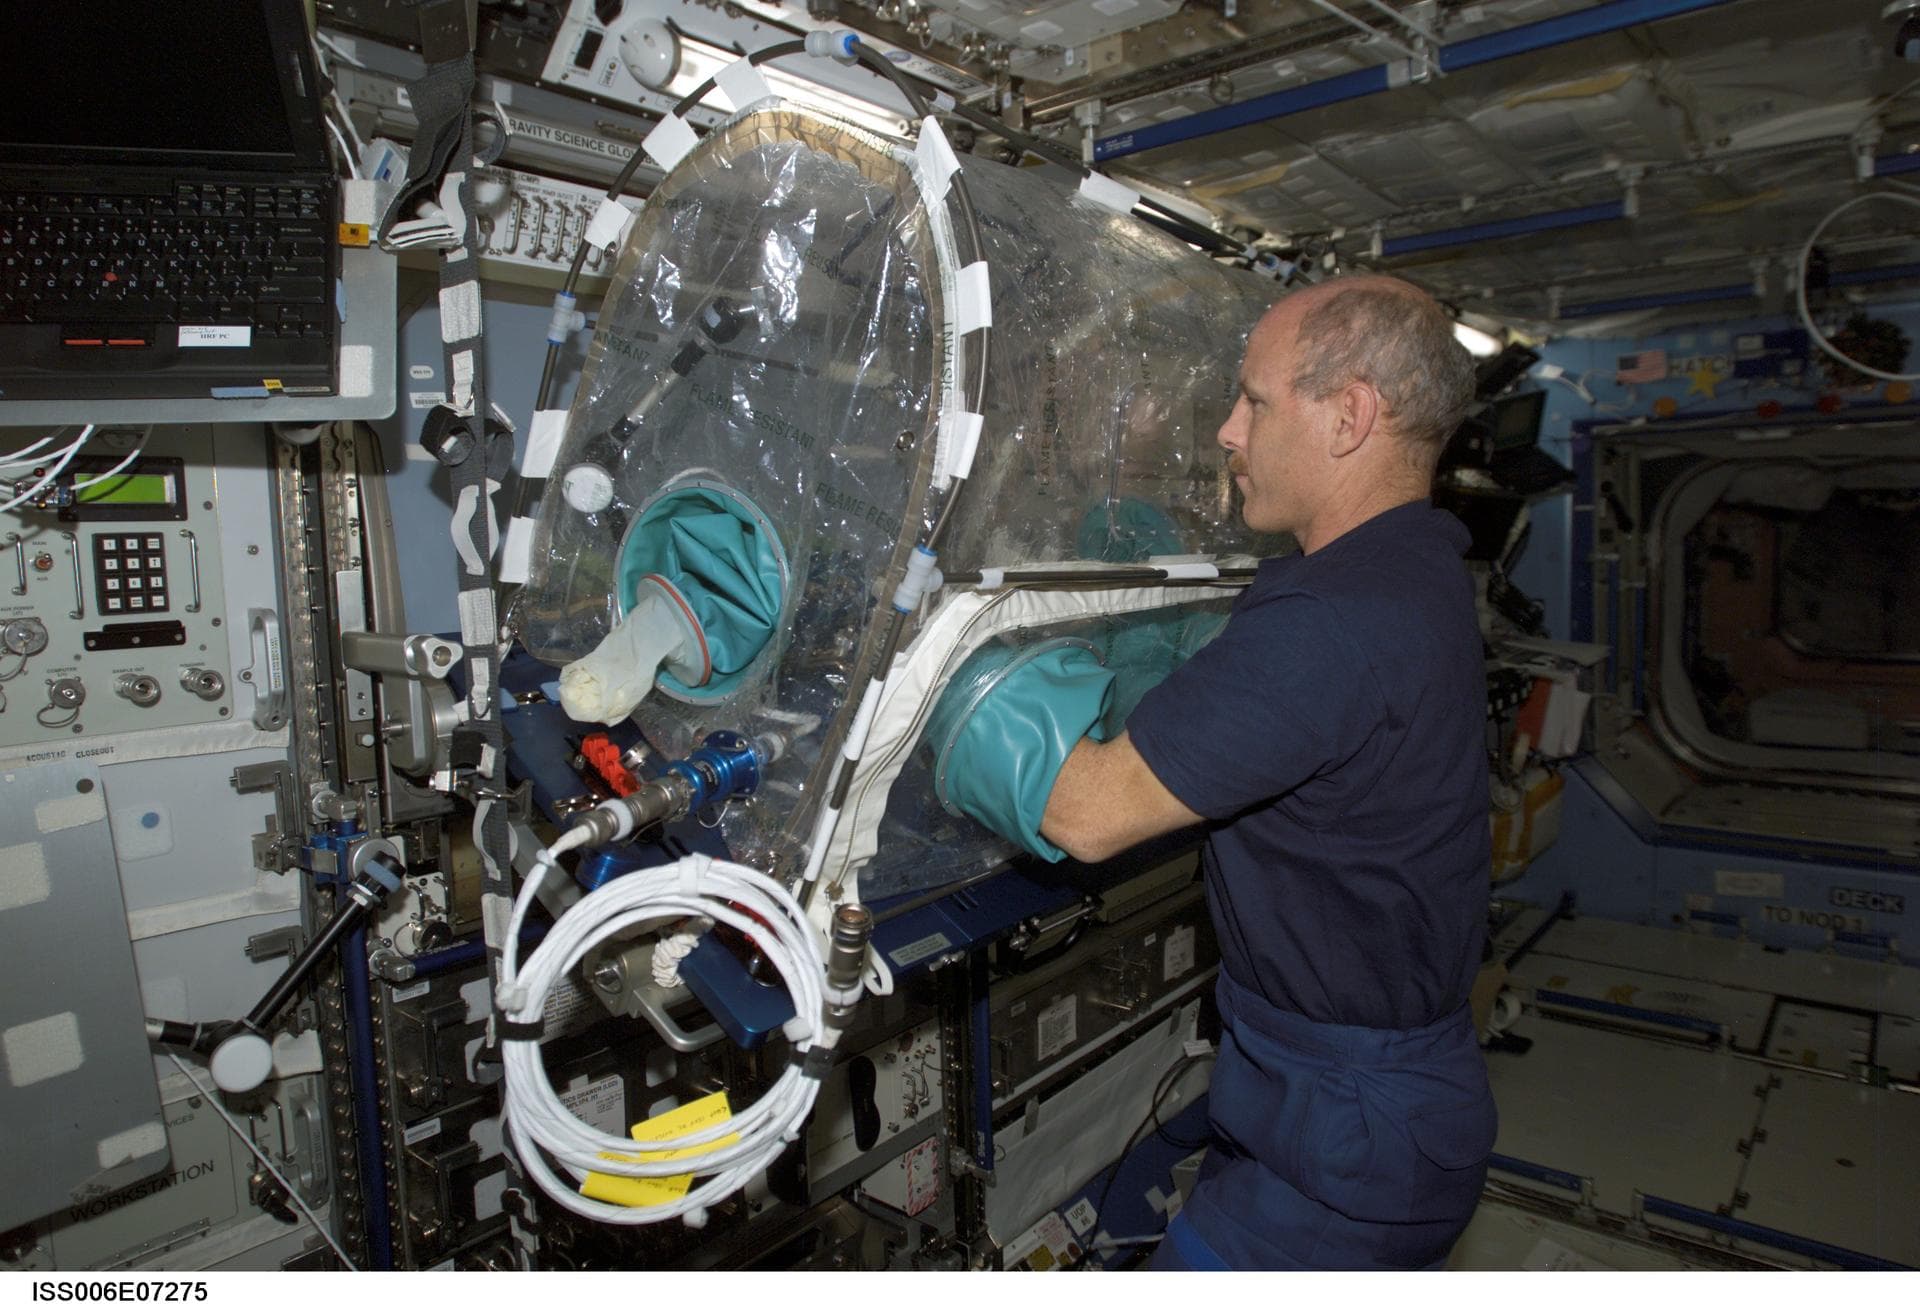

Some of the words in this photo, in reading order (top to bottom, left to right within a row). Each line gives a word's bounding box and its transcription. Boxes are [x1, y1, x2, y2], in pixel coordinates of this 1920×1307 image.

[510, 120, 551, 139] RAVITY
[554, 130, 605, 152] SCIENCE
[749, 408, 816, 448] ESISTANT
[815, 481, 866, 516] FLAME
[75, 746, 115, 759] CLOSEOUT
[1762, 905, 1792, 922] TO
[166, 1113, 194, 1129] VICES
[71, 1159, 214, 1223] WORKSTATION
